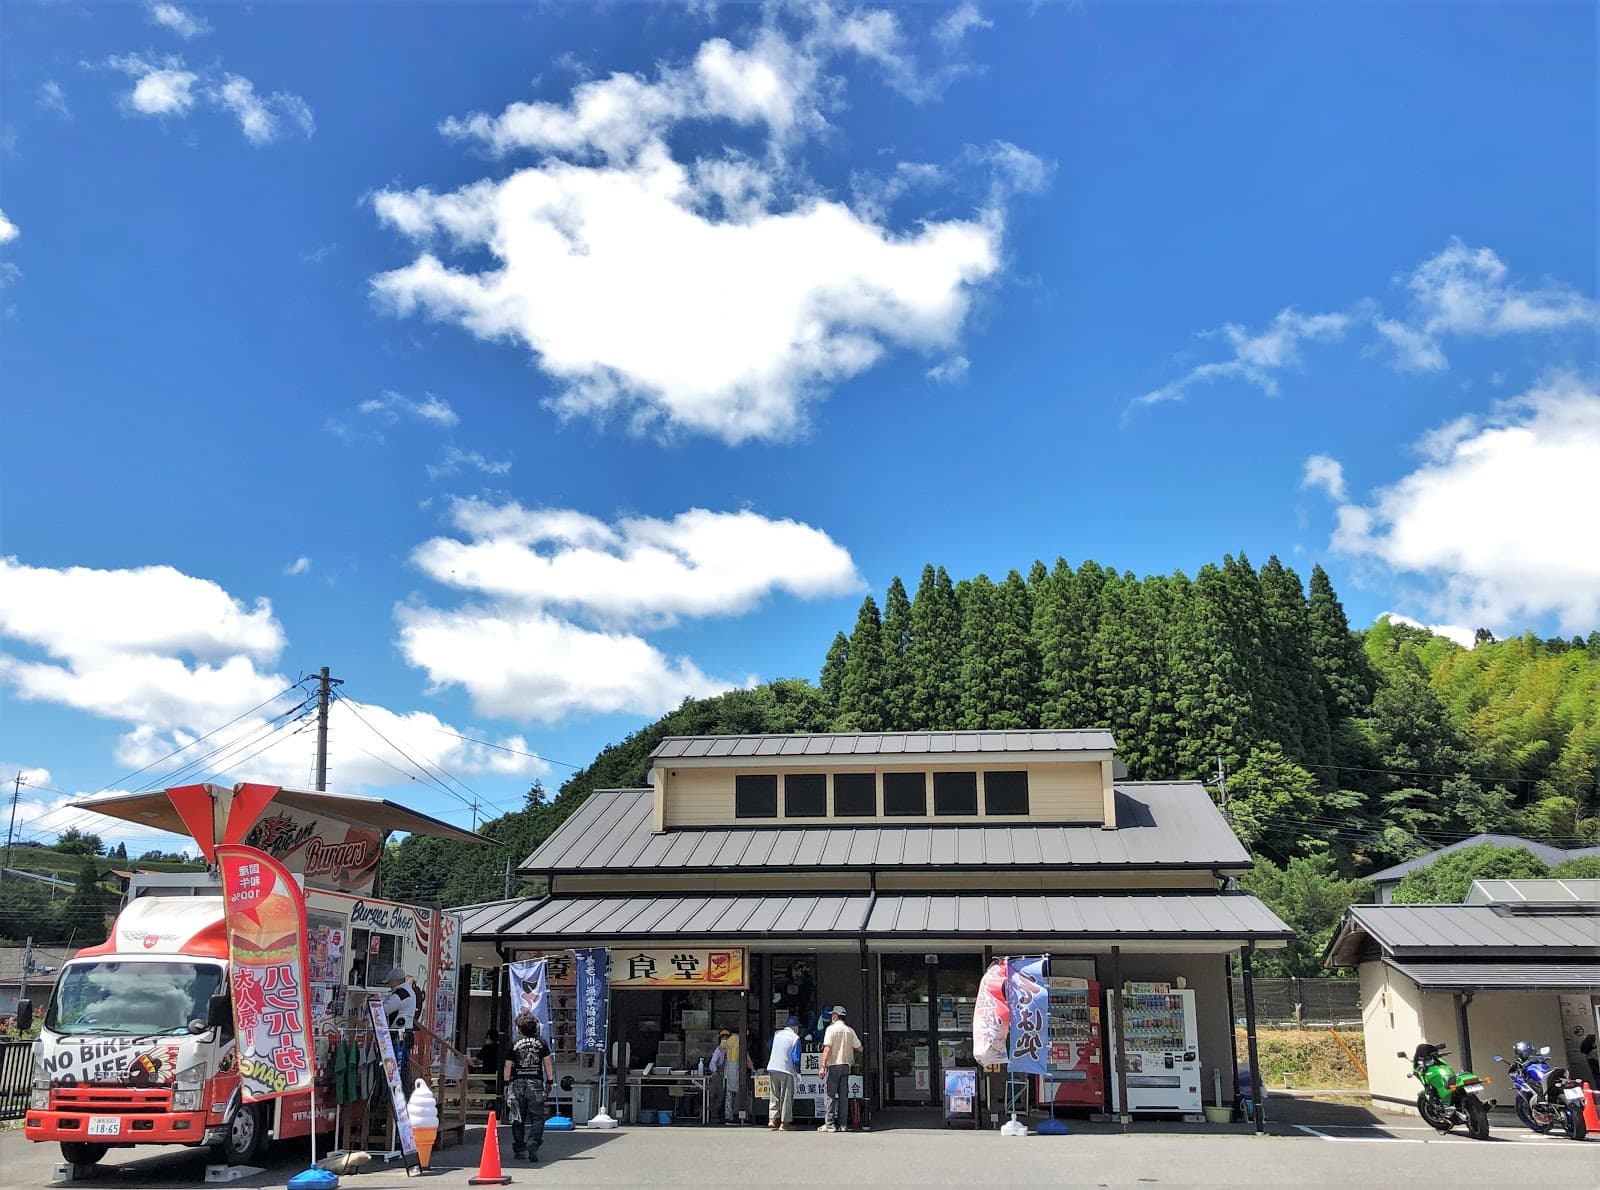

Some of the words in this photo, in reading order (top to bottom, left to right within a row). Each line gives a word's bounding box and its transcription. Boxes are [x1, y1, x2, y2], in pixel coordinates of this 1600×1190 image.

[305, 836, 367, 880] Burgers
[351, 900, 389, 929] Burger
[391, 907, 413, 932] Shop
[44, 1051, 73, 1073] NO
